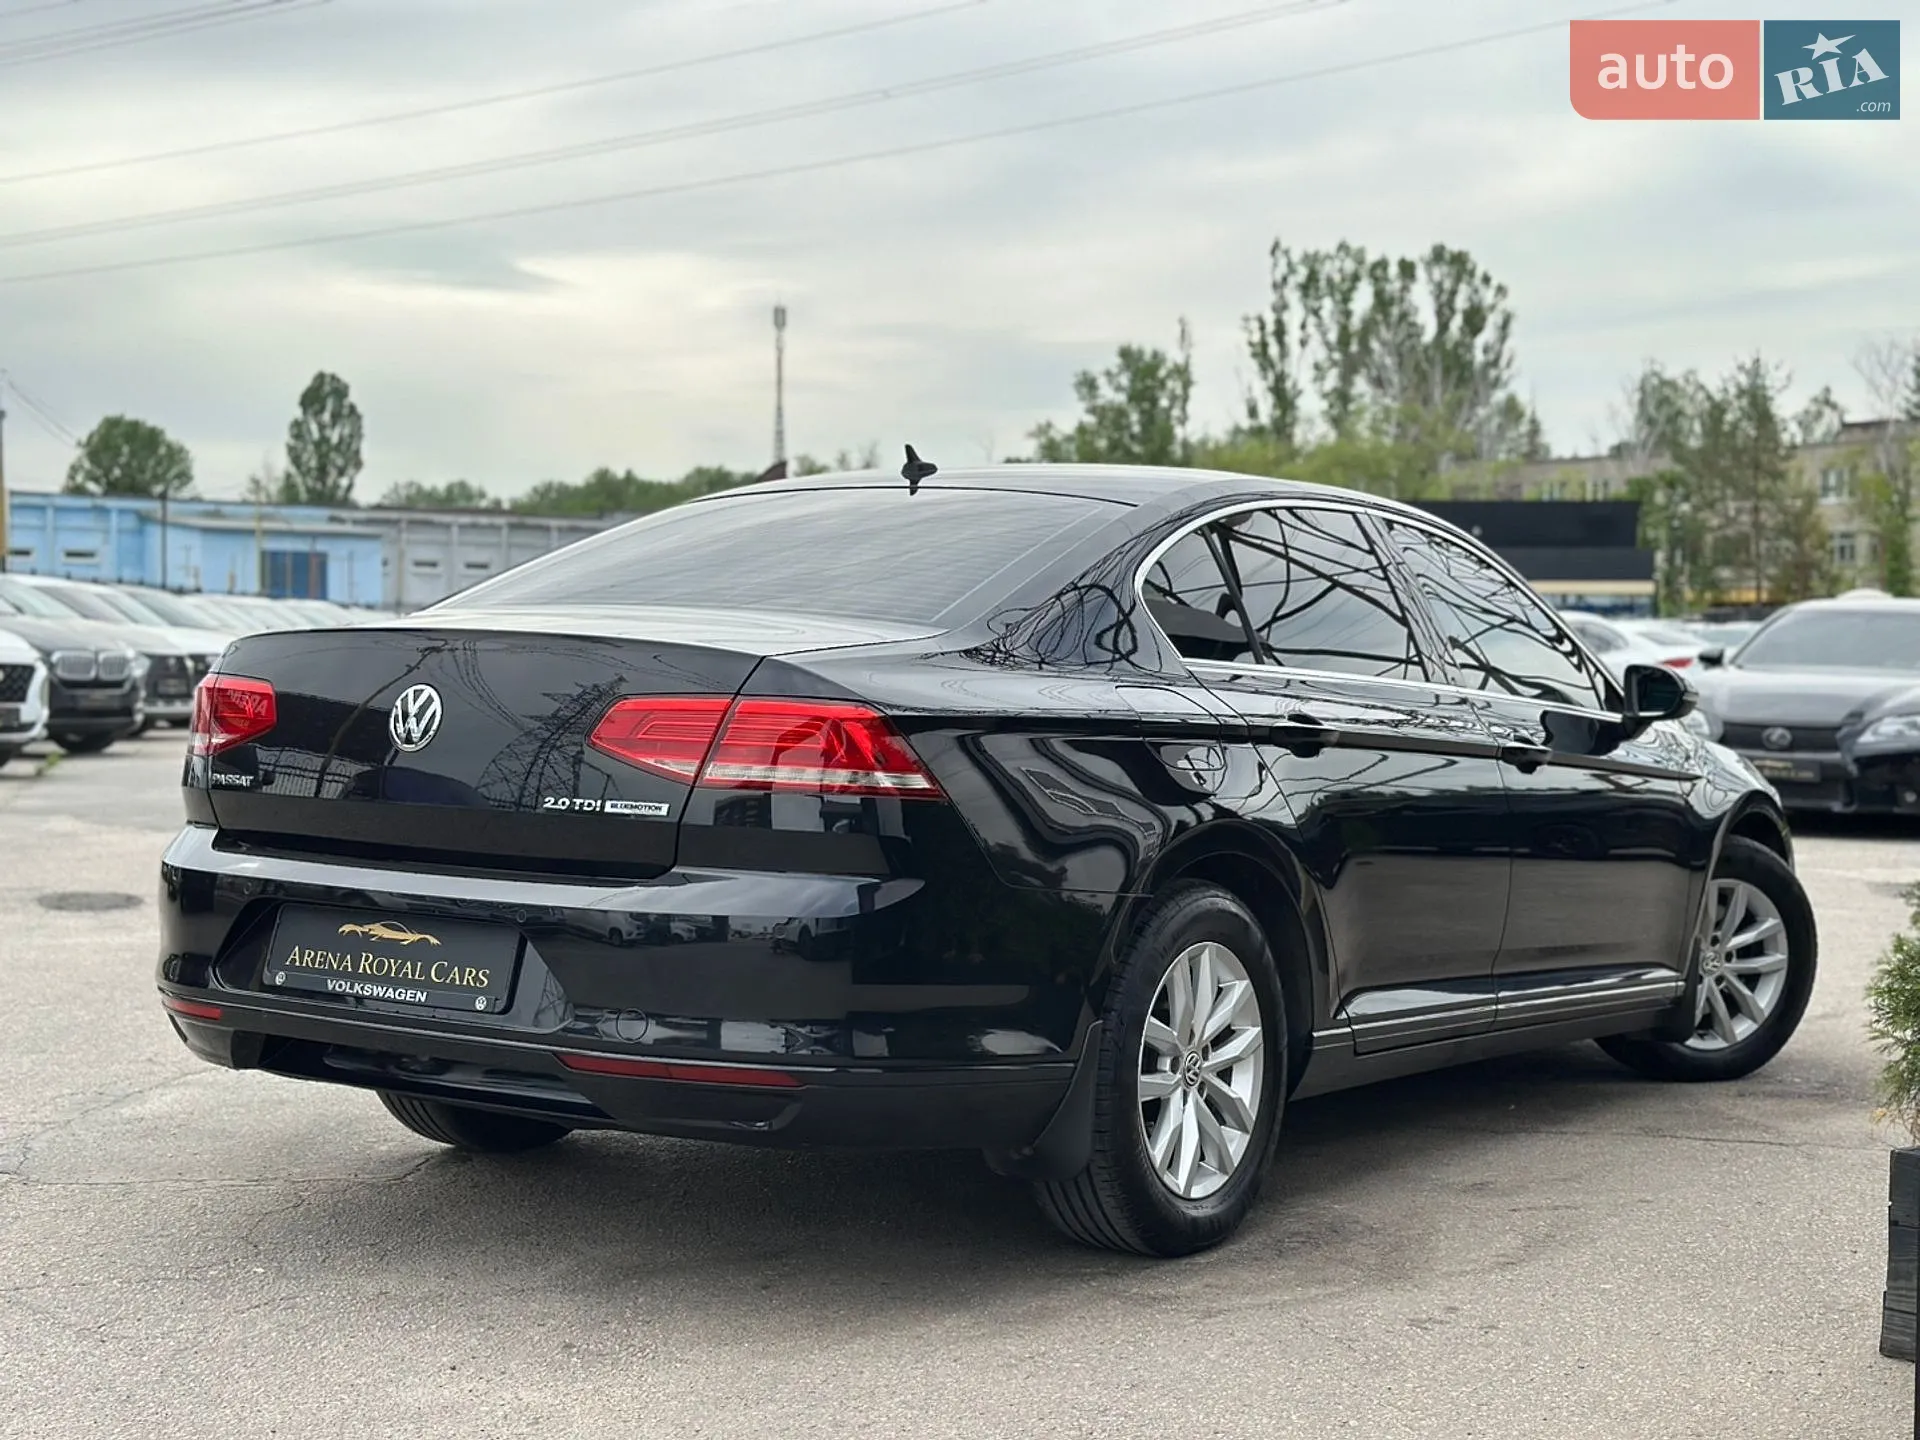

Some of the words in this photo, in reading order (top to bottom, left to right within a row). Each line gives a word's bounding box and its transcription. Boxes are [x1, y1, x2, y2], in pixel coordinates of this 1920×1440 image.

[211, 773, 254, 787] PASSAT
[572, 798, 602, 811] TDI
[285, 946, 353, 972] ARENA
[358, 952, 426, 980] ROYAL
[430, 961, 490, 988] CARS
[326, 978, 427, 1003] VOLKSWAGEN
